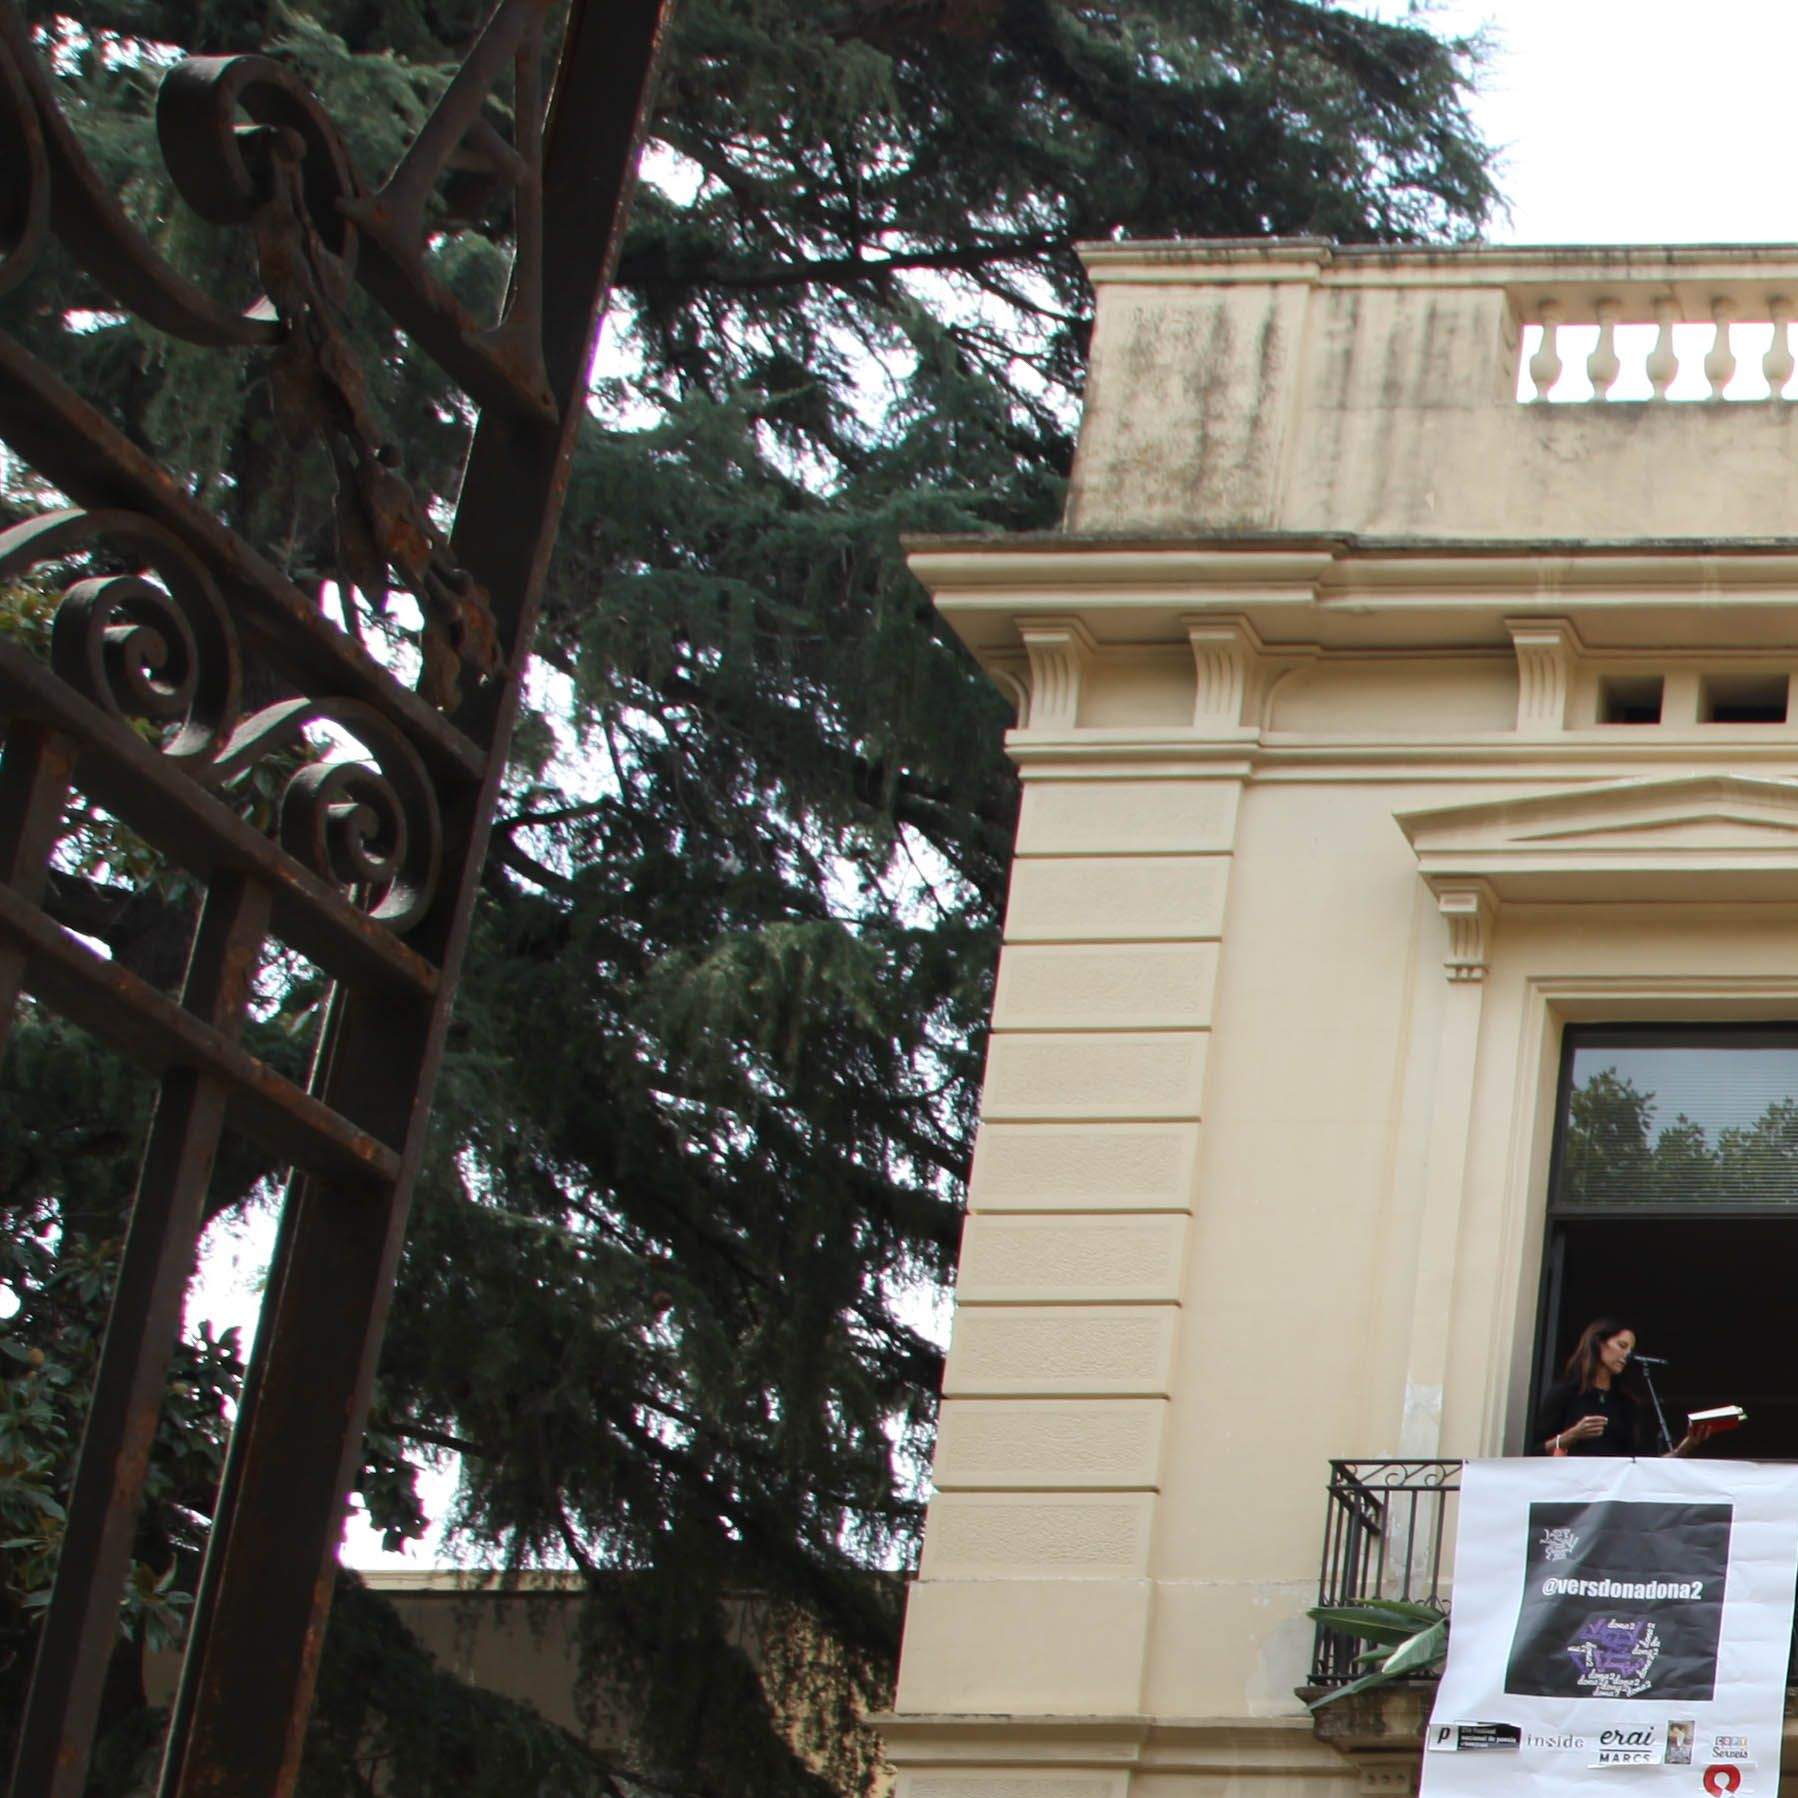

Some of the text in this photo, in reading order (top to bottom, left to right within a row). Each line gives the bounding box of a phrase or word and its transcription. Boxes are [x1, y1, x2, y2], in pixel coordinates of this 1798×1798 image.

[1542, 1577, 1704, 1600] @versdonadona2
[1527, 1734, 1585, 1748] inside
[1600, 1726, 1655, 1746] erai
